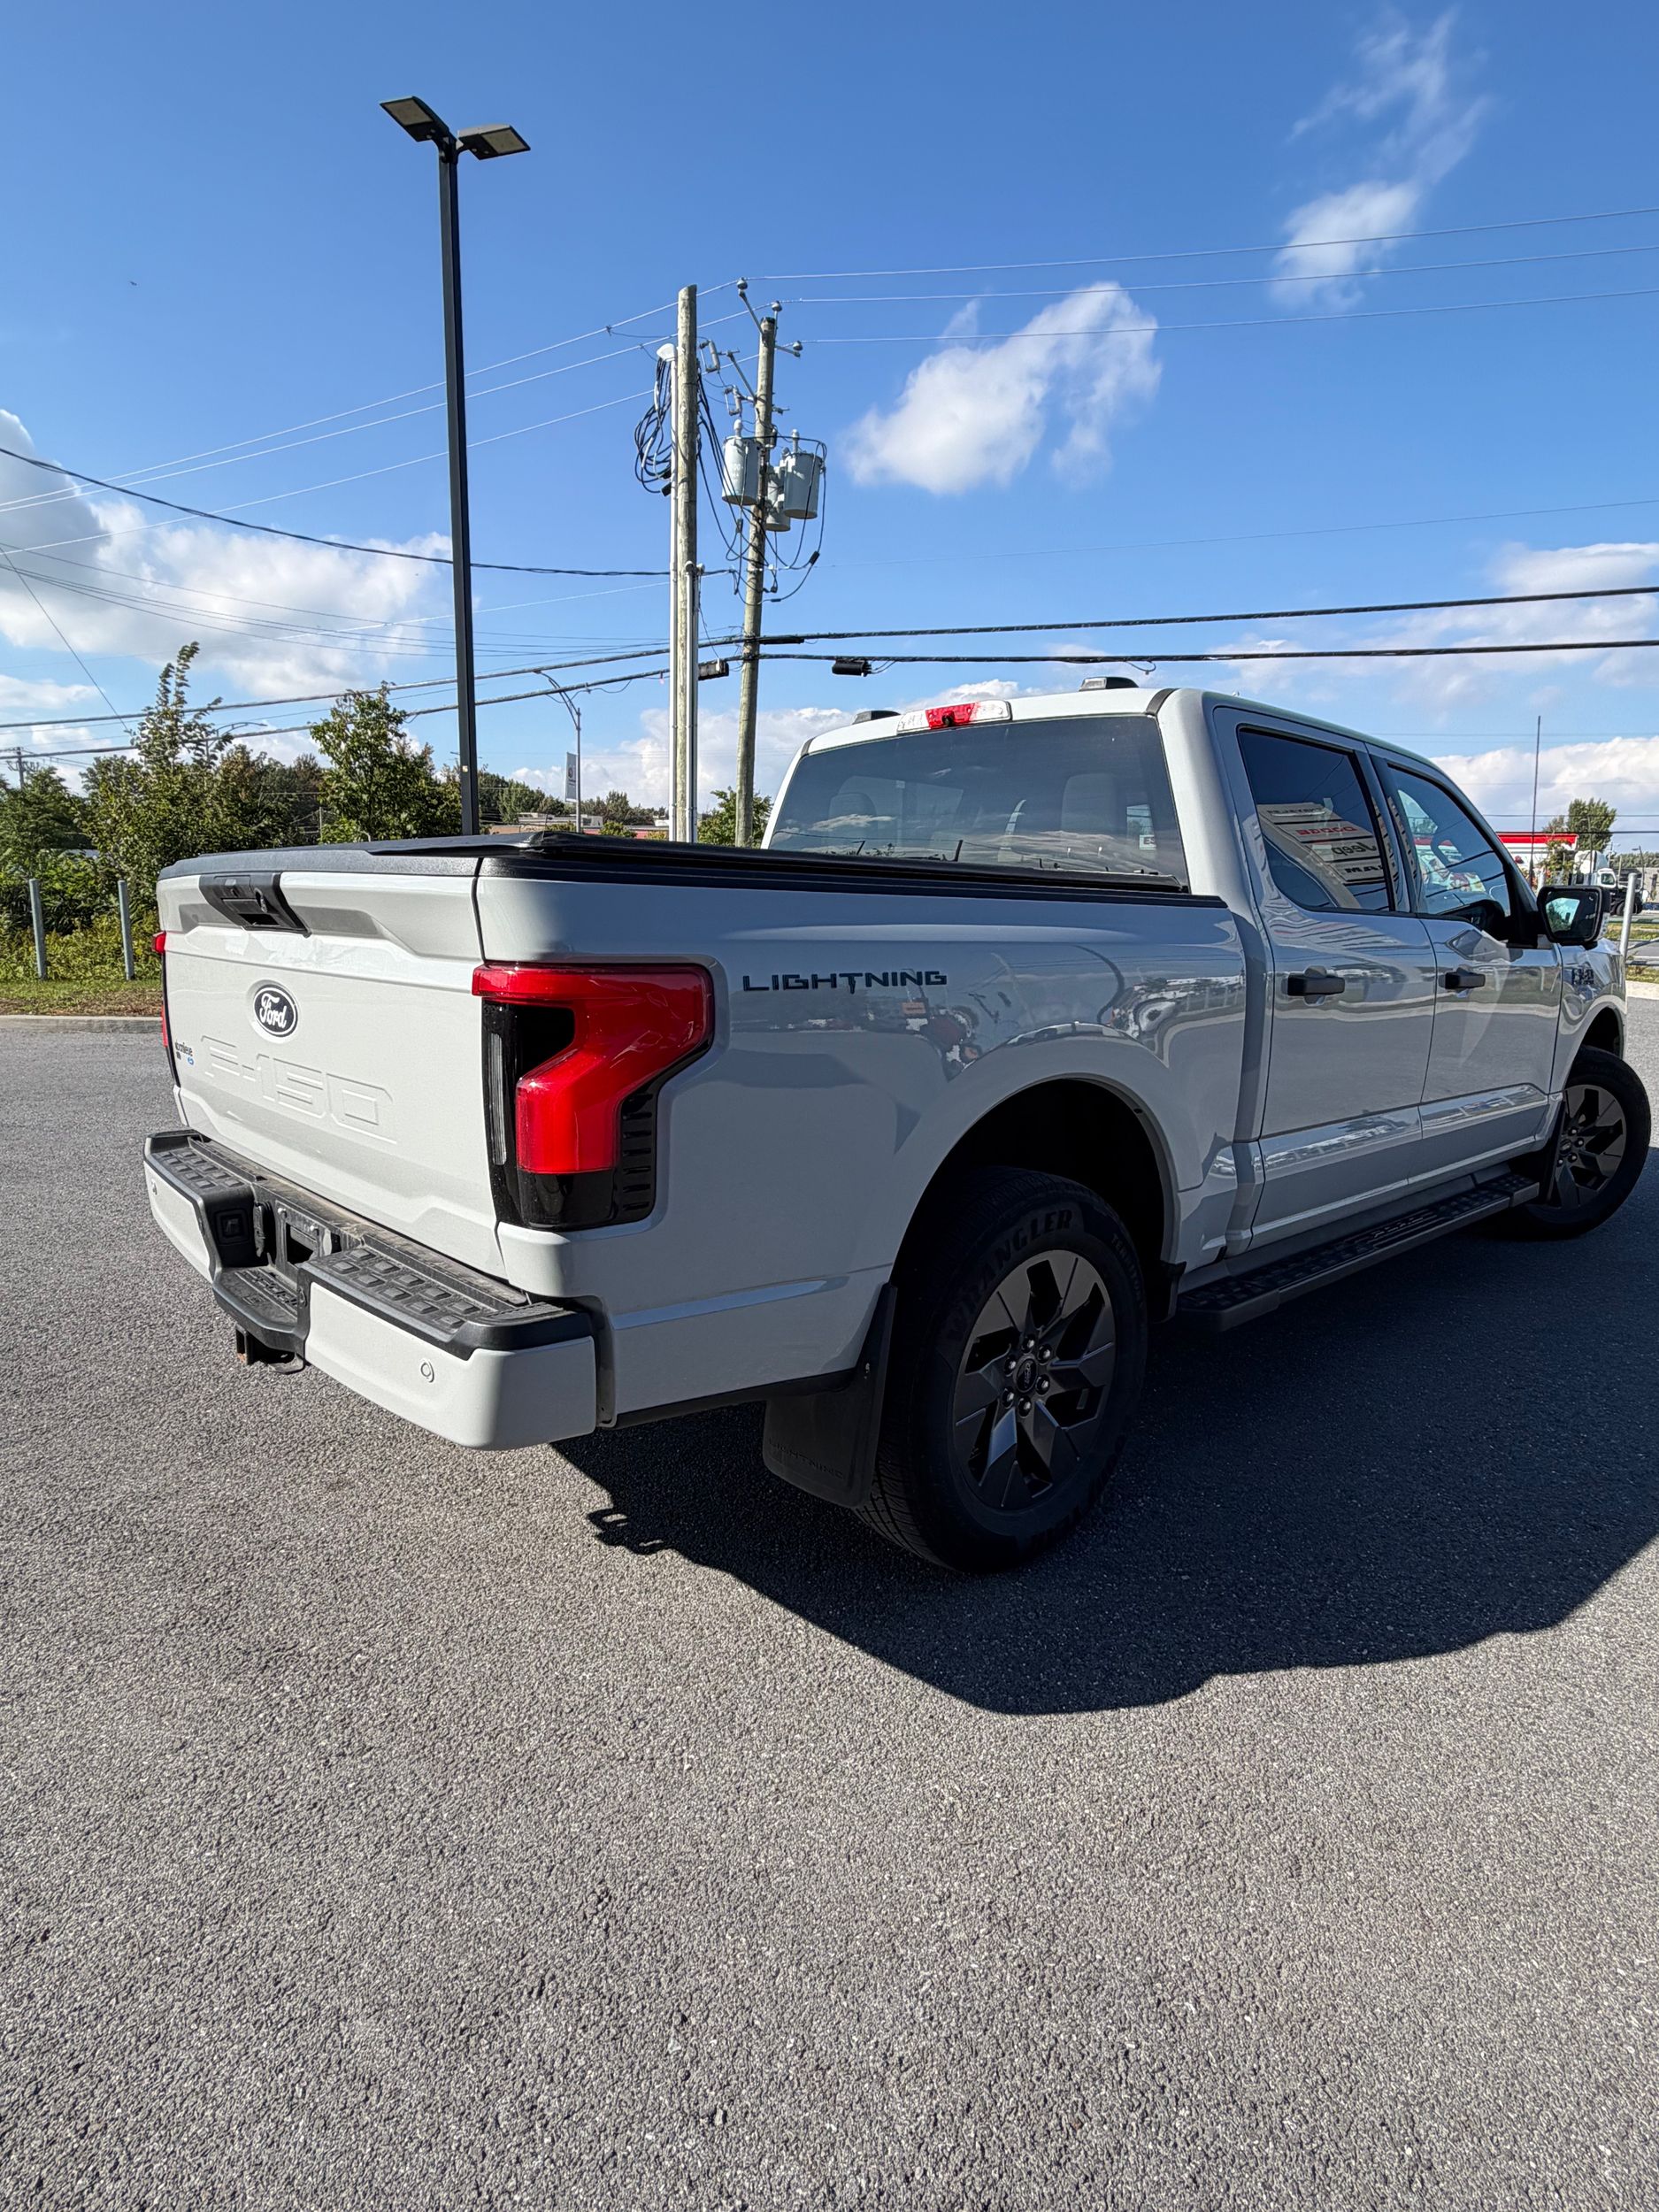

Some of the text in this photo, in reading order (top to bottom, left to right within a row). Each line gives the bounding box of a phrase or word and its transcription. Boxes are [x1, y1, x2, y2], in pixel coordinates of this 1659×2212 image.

[742, 971, 948, 994] LIGHTNING
[258, 993, 288, 1029] Ford
[202, 1035, 397, 1144] F-150
